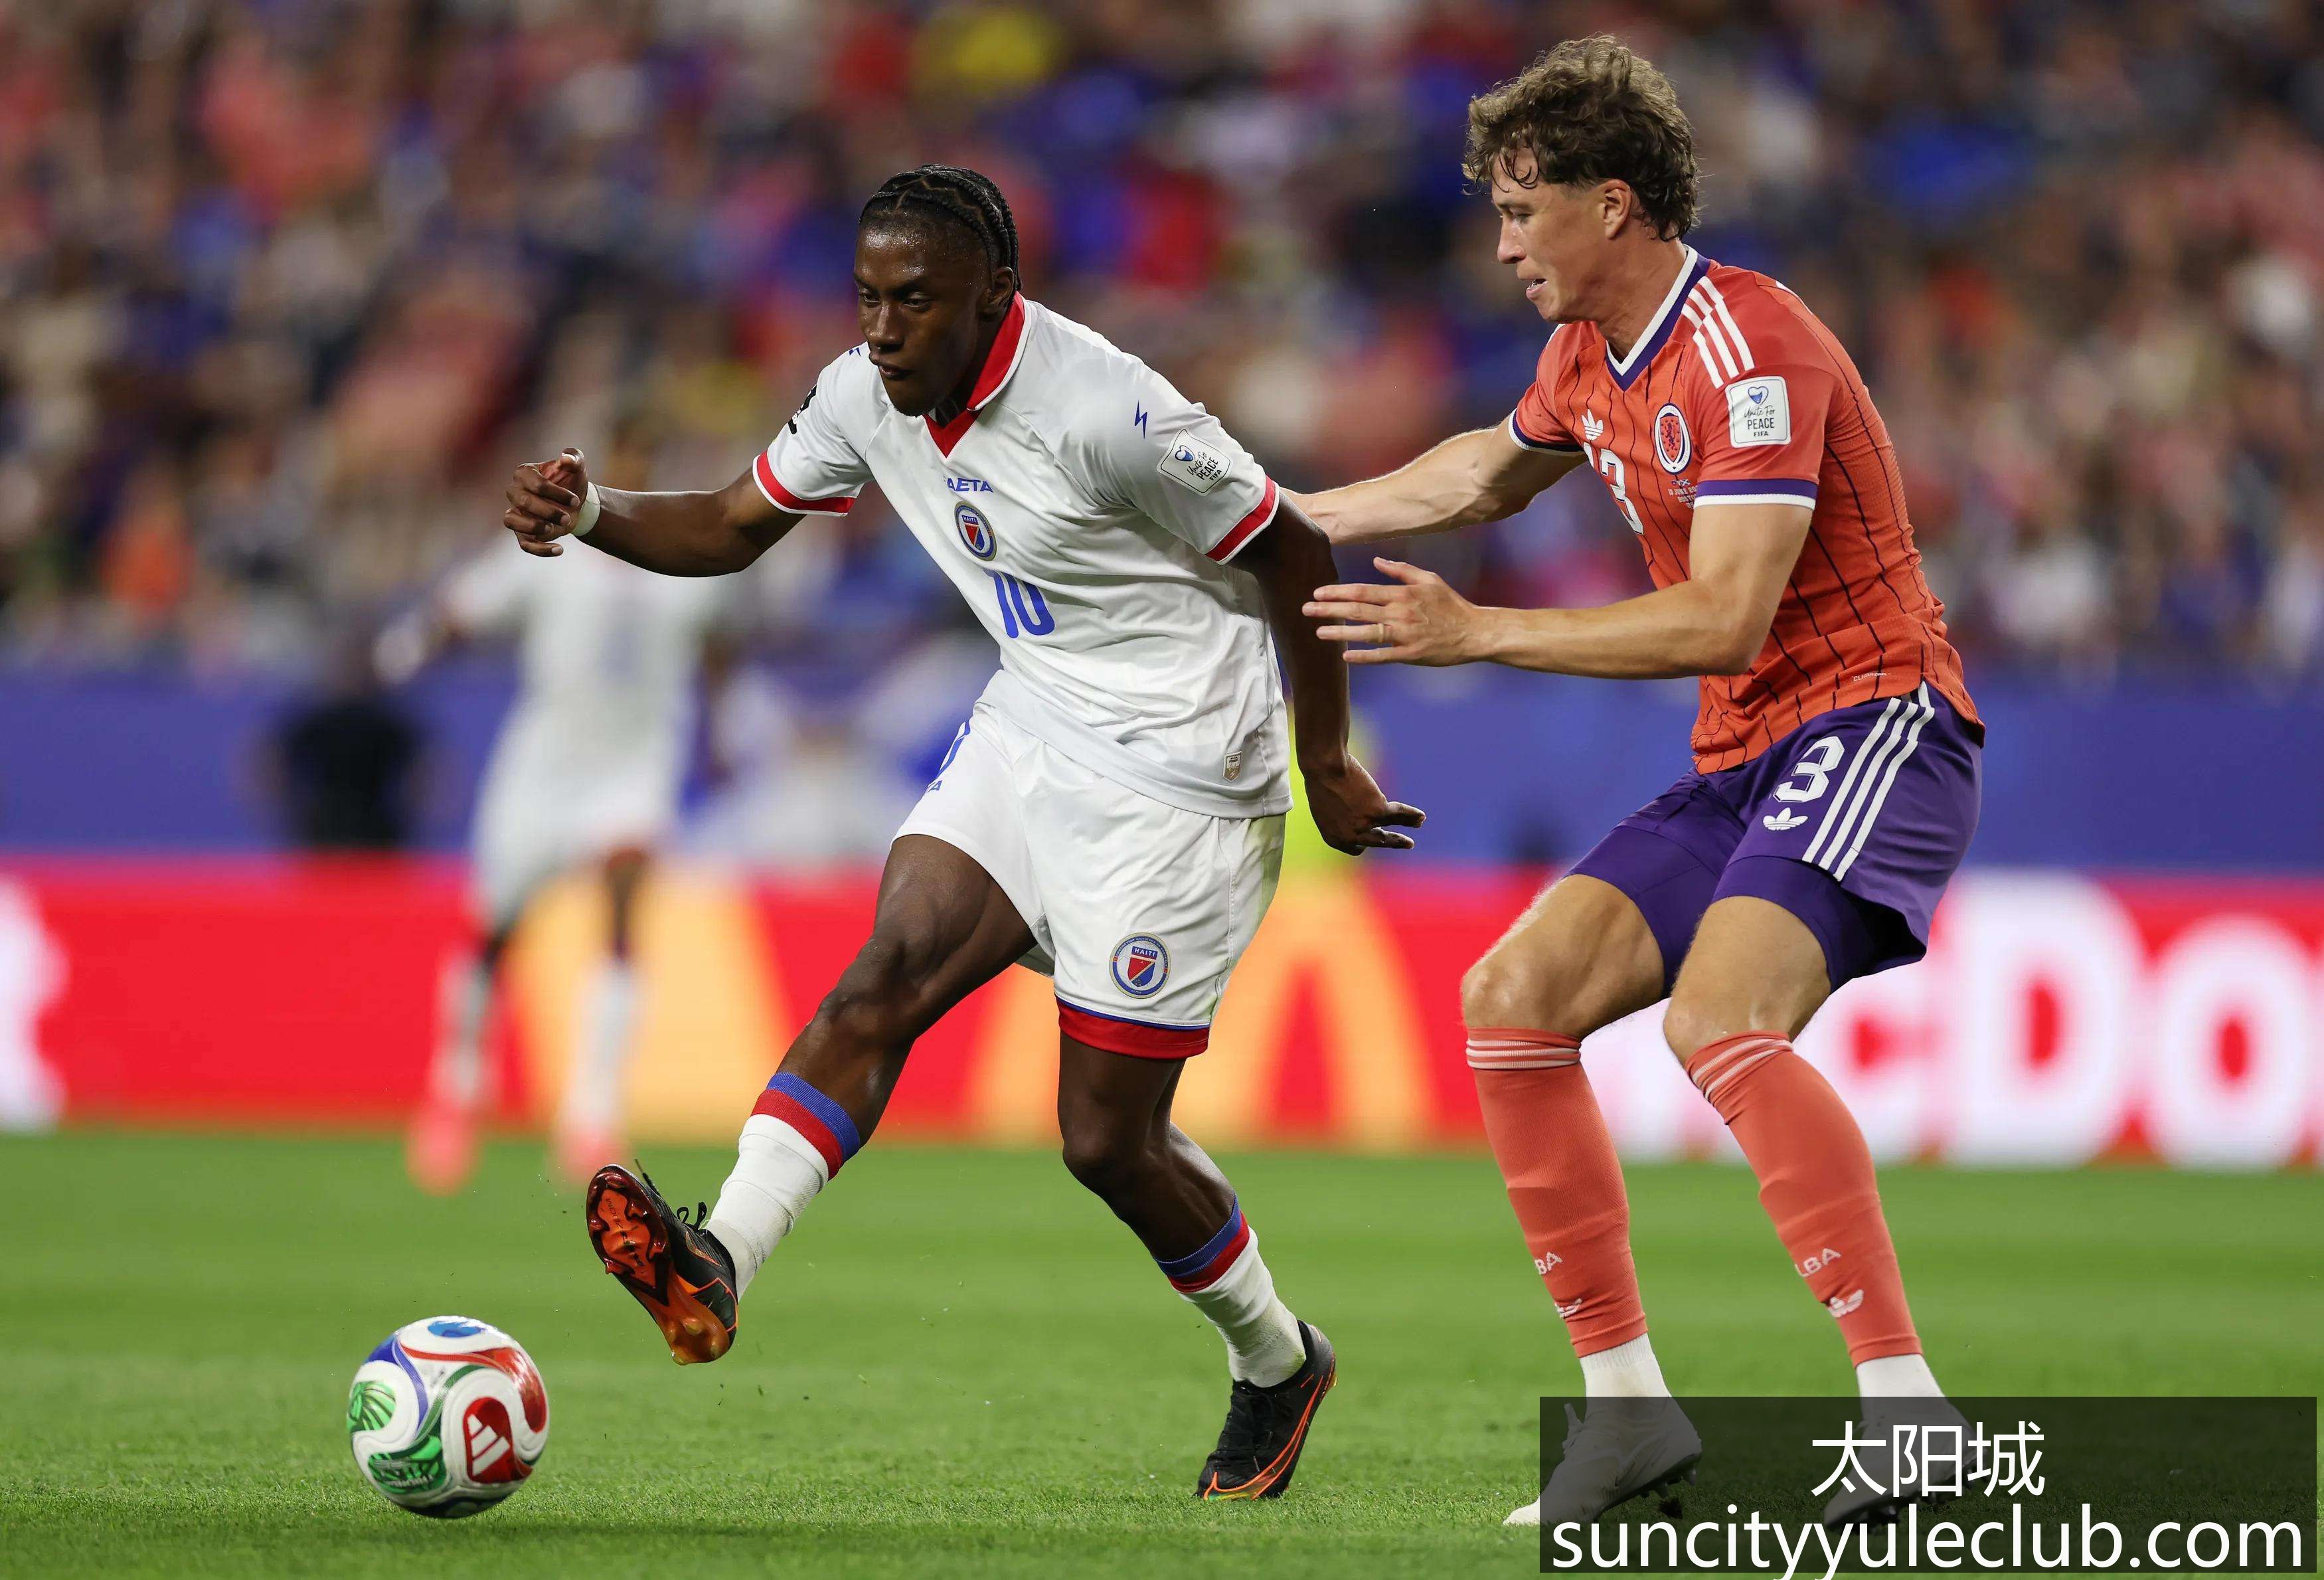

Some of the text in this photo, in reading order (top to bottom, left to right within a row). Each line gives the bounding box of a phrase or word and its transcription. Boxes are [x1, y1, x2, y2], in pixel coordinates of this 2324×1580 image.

[1744, 405, 1776, 418] Unite For
[1747, 418, 1775, 430] PEACE
[1187, 460, 1203, 476] Unite
[1196, 457, 1218, 480] PEACE
[1209, 470, 1222, 481] FIFA
[944, 477, 994, 493] AETA
[983, 569, 1055, 639] 10
[1134, 948, 1155, 957] HAITI
